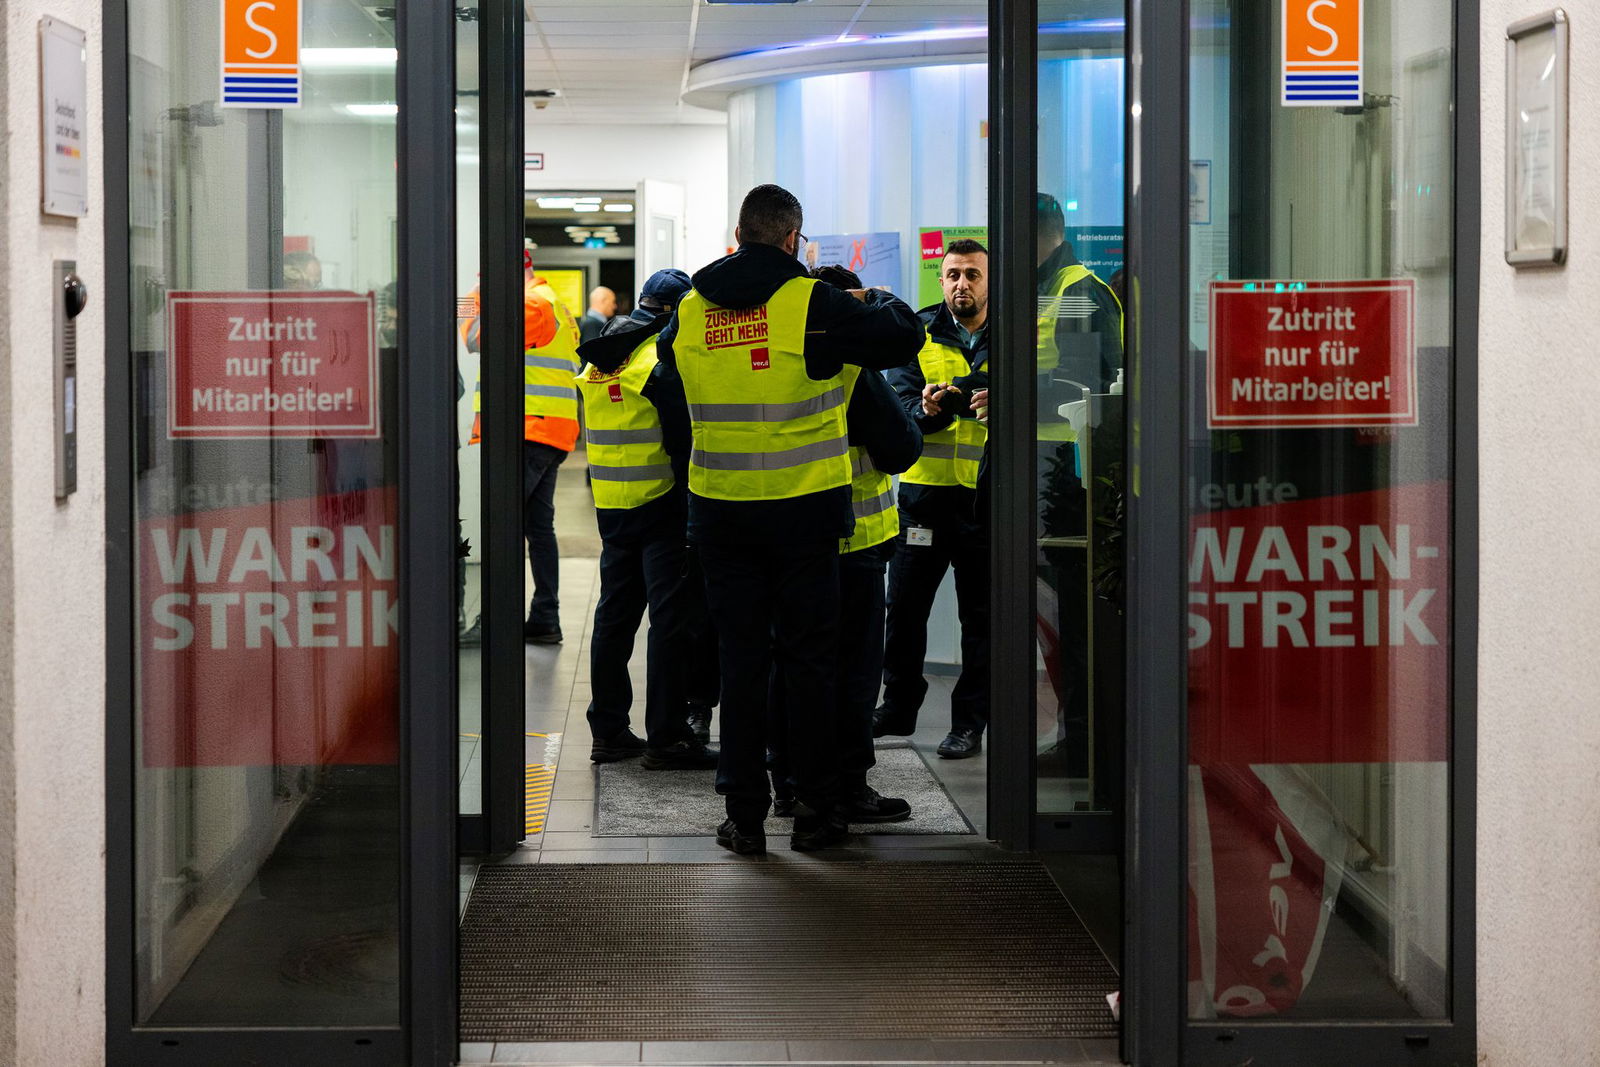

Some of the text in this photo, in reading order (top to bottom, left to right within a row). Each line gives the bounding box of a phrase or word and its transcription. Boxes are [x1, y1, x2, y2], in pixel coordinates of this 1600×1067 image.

[245, 1, 278, 58] S
[1306, 0, 1339, 56] S
[227, 315, 318, 342] Zutritt
[704, 304, 768, 329] ZUSAMMEN
[1266, 306, 1356, 332] Zutritt
[704, 321, 769, 345] GEHT MEHR
[225, 351, 321, 377] nur für
[1264, 340, 1360, 367] nur für
[191, 387, 354, 413] Mitarbeiter!
[1231, 375, 1391, 402] Mitarbeiter!
[1188, 475, 1299, 509] eute
[151, 524, 395, 584] WARN
[1188, 523, 1439, 583] WARN-
[1187, 588, 1439, 649] STREIK
